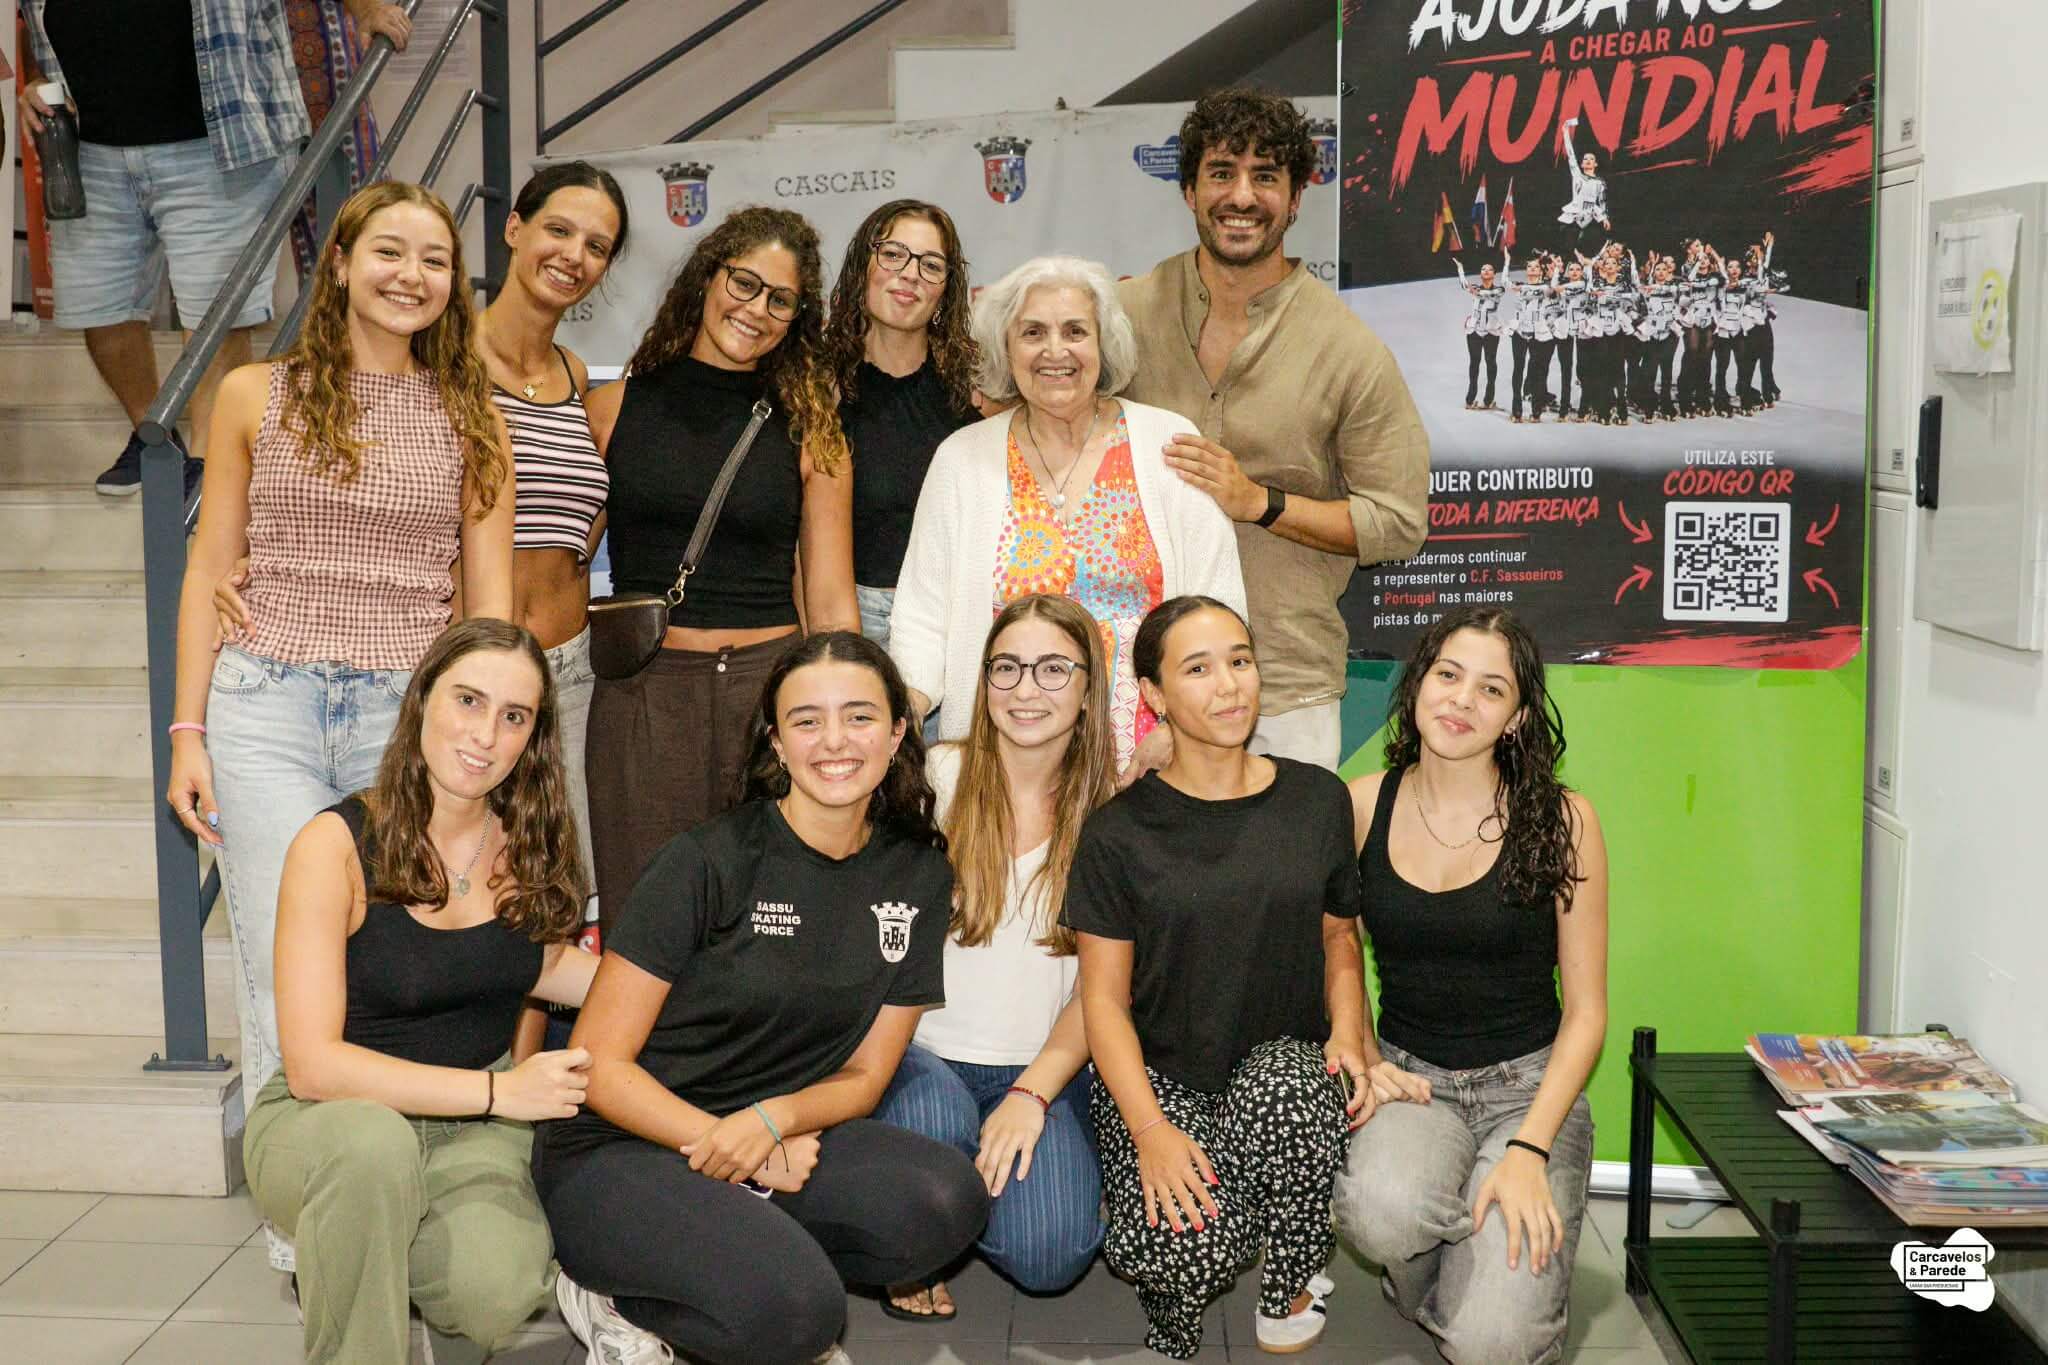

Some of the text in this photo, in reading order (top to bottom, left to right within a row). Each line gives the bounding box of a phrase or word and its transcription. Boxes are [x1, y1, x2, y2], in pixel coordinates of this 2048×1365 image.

[1540, 23, 1715, 63] A CHEGAR AO
[1389, 36, 1848, 199] MUNDIAL
[775, 169, 896, 198] CASCAIS
[1684, 450, 1775, 466] UTILIZA ESTE
[1477, 467, 1593, 492] CONTRIBUTO
[1663, 465, 1795, 496] CÓDIGO QR
[1425, 496, 1600, 527] TODA A DIFERENÇA
[1405, 552, 1464, 568] podermos
[1468, 550, 1527, 563] continuar
[1373, 575, 1380, 586] a
[1459, 573, 1467, 584] o
[1470, 569, 1493, 584] C.F.
[1496, 567, 1564, 583] Sassoeiros
[1373, 589, 1513, 608] e Portugal nas maiores
[1374, 612, 1410, 629] pistas
[1414, 611, 1428, 625] do
[753, 924, 795, 936] FORCE
